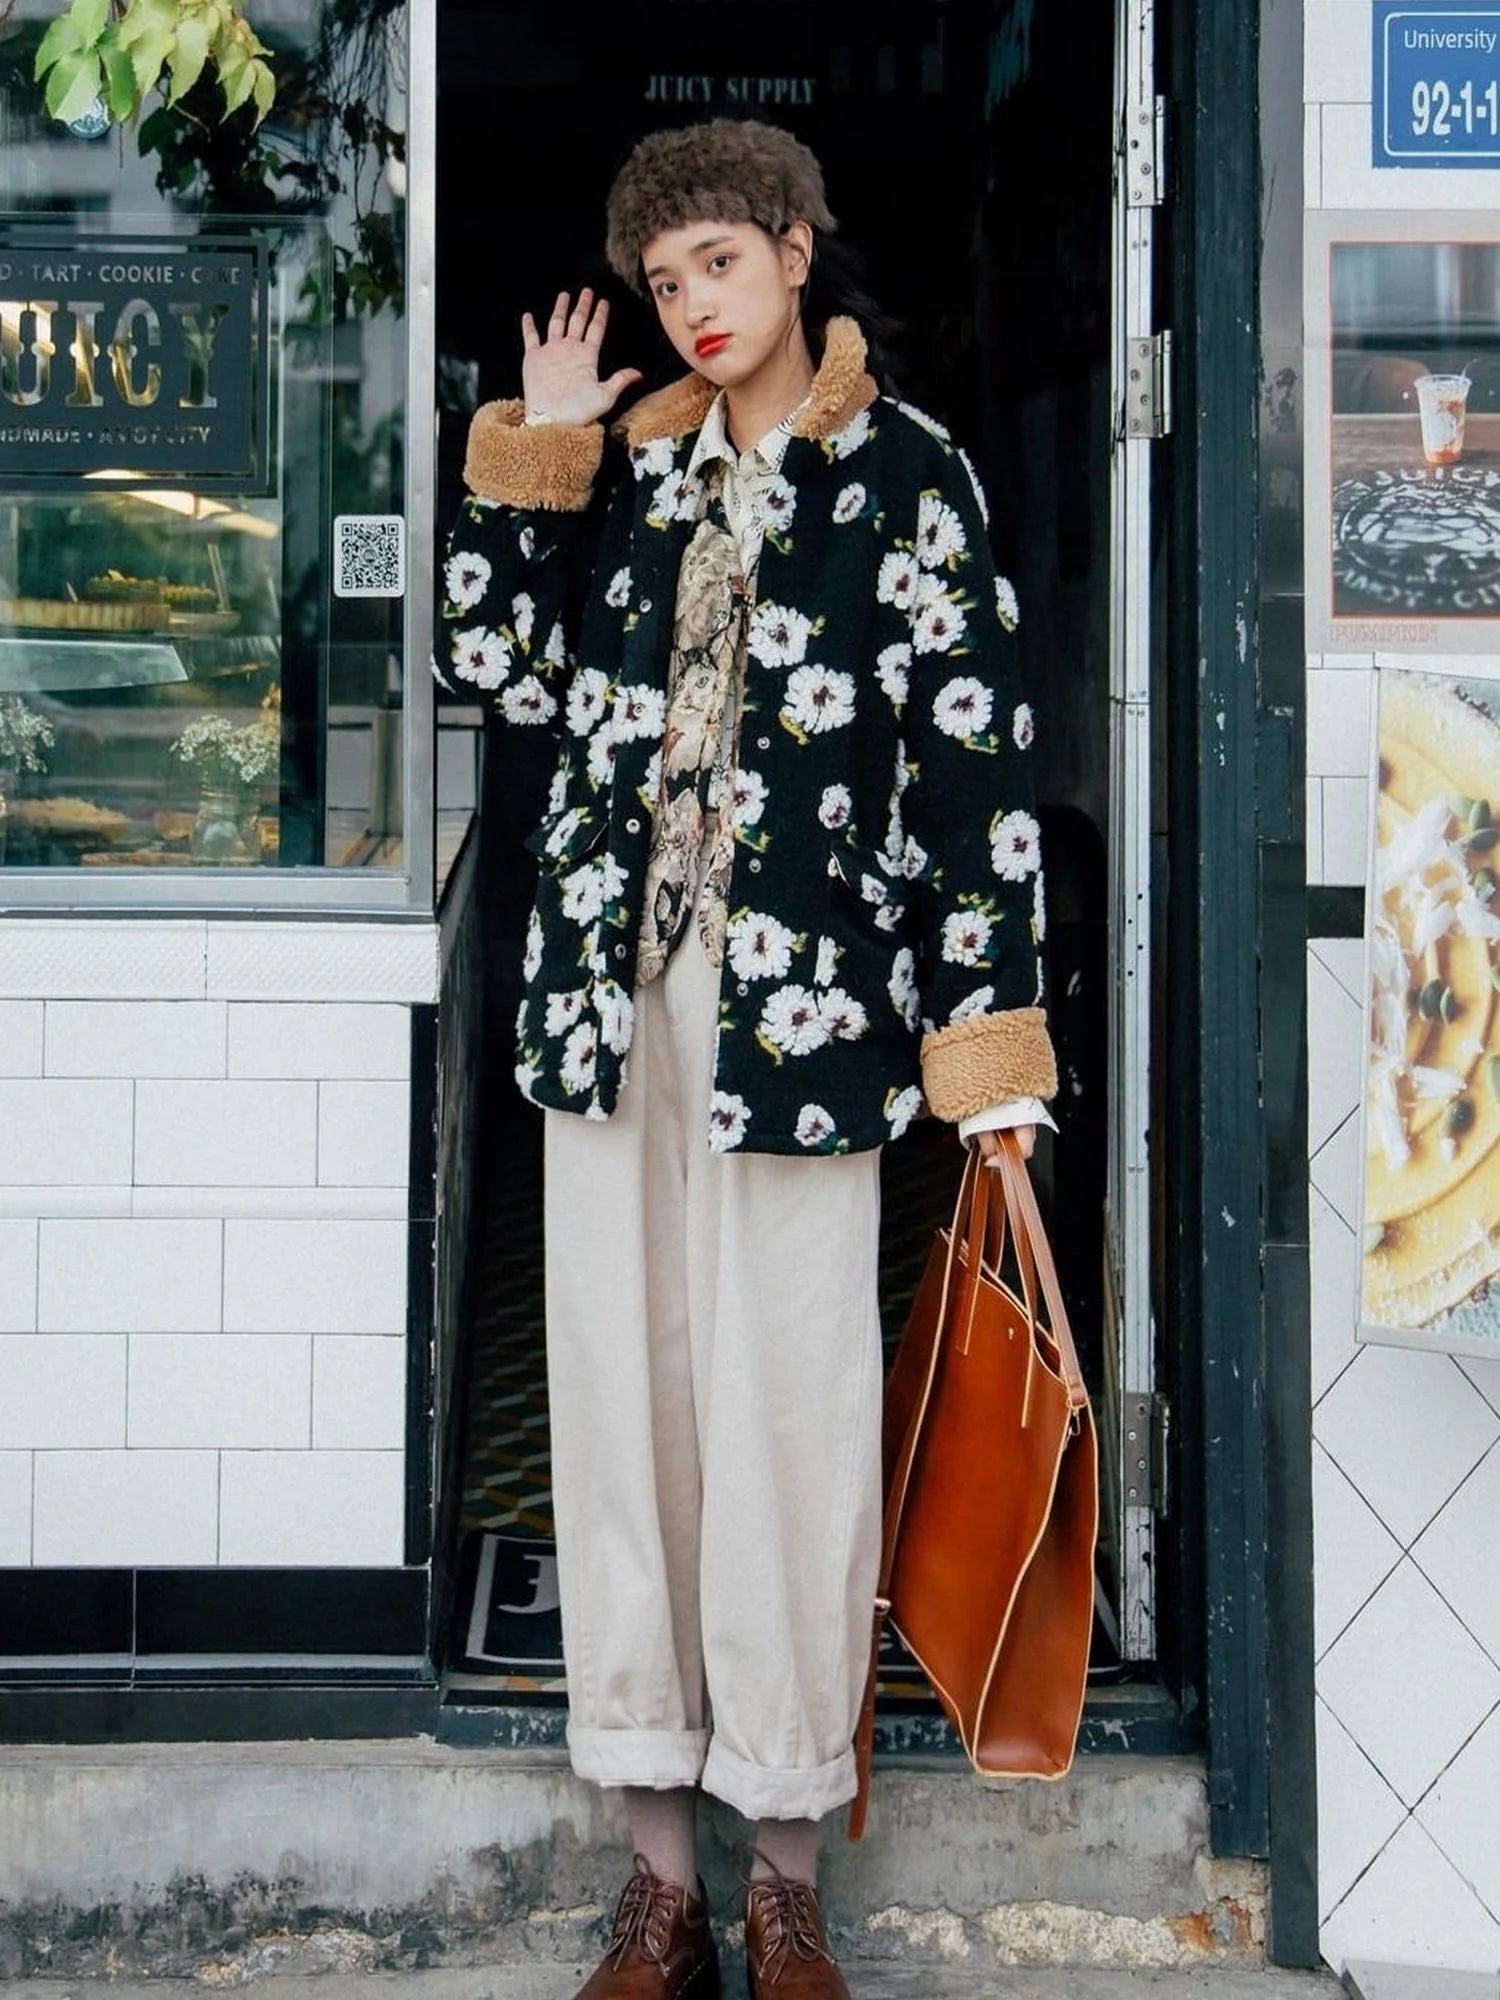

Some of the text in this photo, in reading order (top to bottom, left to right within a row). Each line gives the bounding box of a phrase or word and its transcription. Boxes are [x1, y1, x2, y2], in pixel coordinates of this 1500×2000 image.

[1404, 28, 1497, 54] University
[645, 75, 815, 104] JUICY SUPPLY
[33, 264, 81, 283] TART
[99, 265, 174, 283] COOKIE
